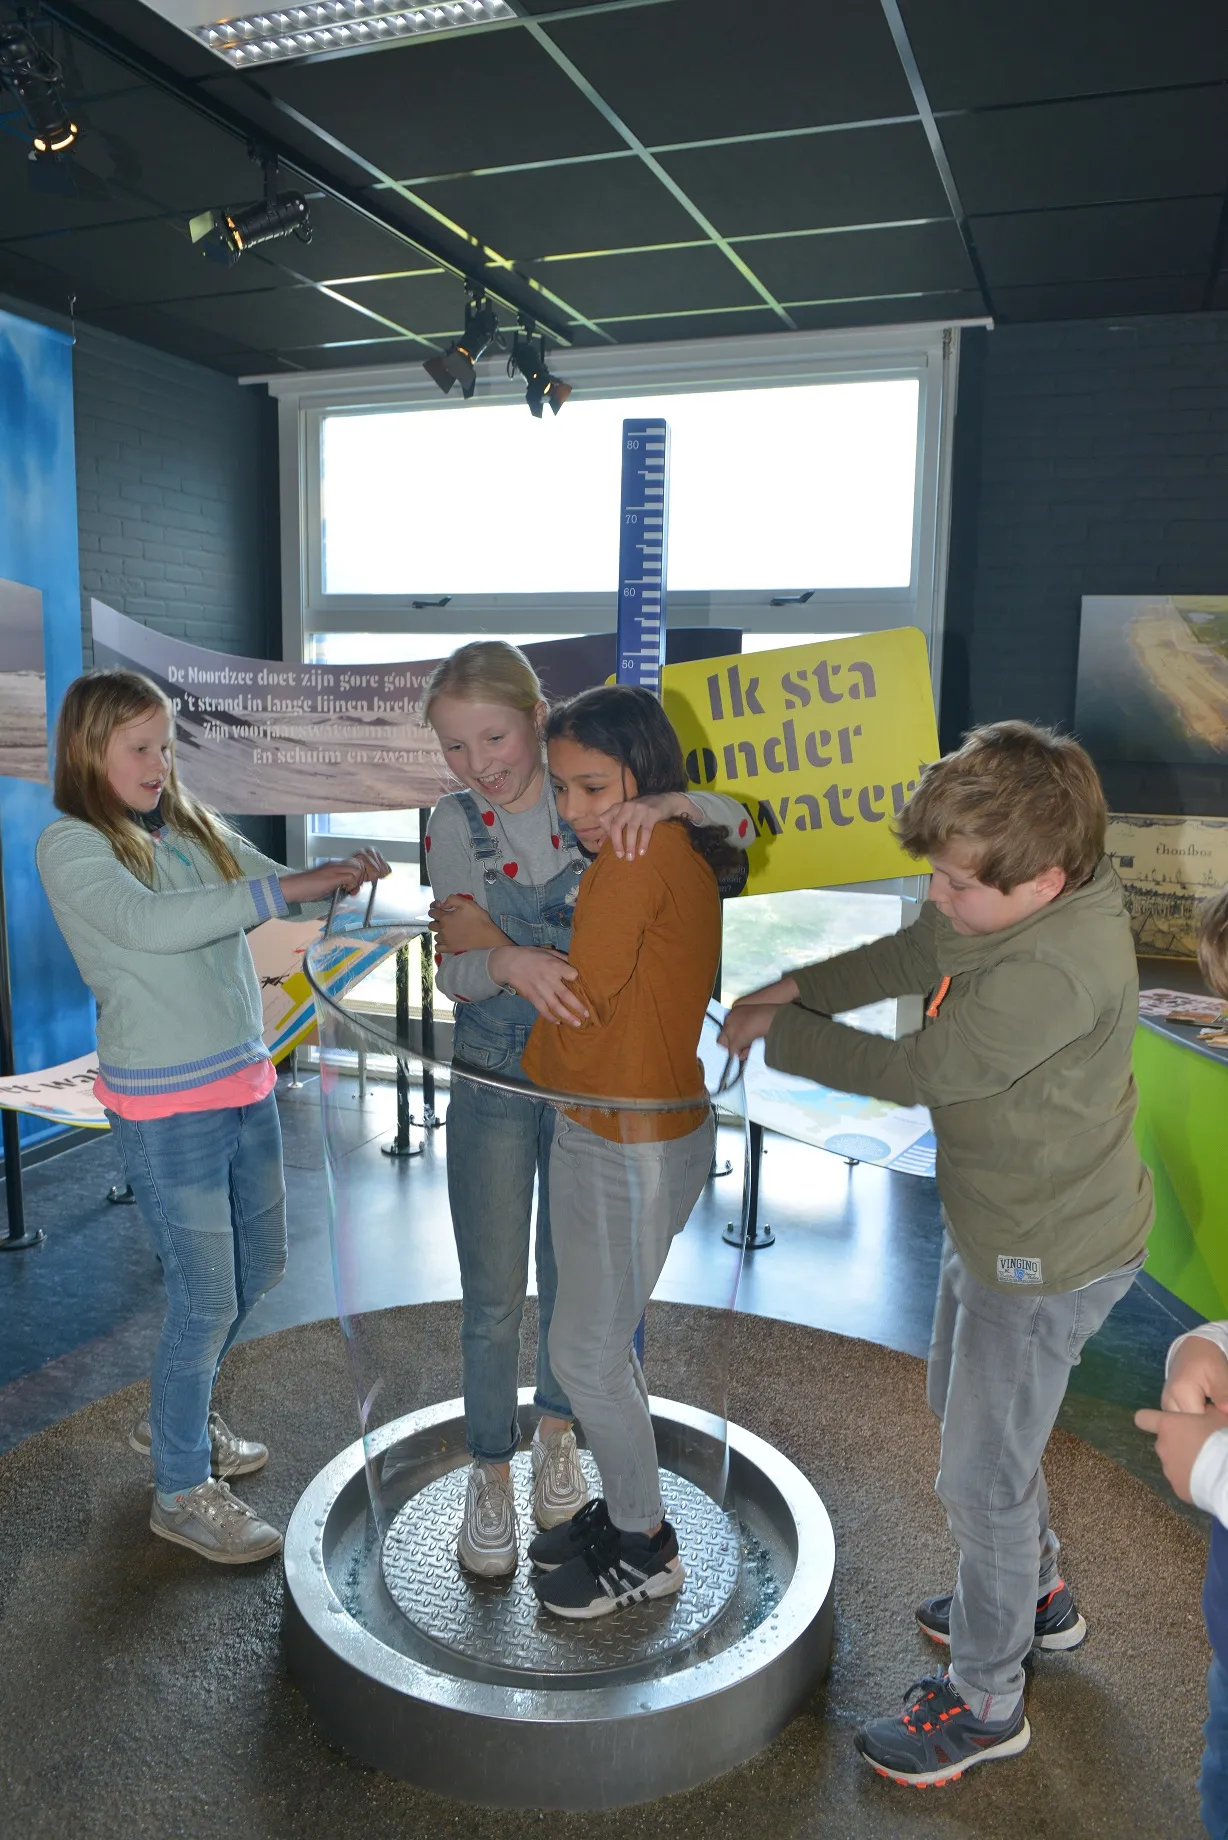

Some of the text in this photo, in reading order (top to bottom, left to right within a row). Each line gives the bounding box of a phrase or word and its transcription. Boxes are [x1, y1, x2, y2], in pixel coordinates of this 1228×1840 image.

[626, 439, 640, 450] 80
[625, 514, 638, 524] 70
[623, 587, 636, 597] 60
[621, 659, 634, 669] 50
[168, 665, 185, 683] De
[188, 666, 254, 685] Noordzee
[257, 667, 297, 686] doet
[300, 669, 334, 692] zijn
[339, 671, 379, 692] gore
[706, 659, 877, 721] Ik sta
[198, 694, 243, 712] strand
[247, 694, 262, 712] in
[267, 694, 312, 716] lange
[317, 695, 368, 715] lijnen
[203, 721, 229, 743] Zijn
[253, 748, 272, 764] En
[277, 746, 341, 764] schuim
[347, 749, 368, 763] en
[374, 749, 426, 764] zwart
[685, 718, 863, 785] onder
[1000, 1258, 1038, 1273] VINGINO
